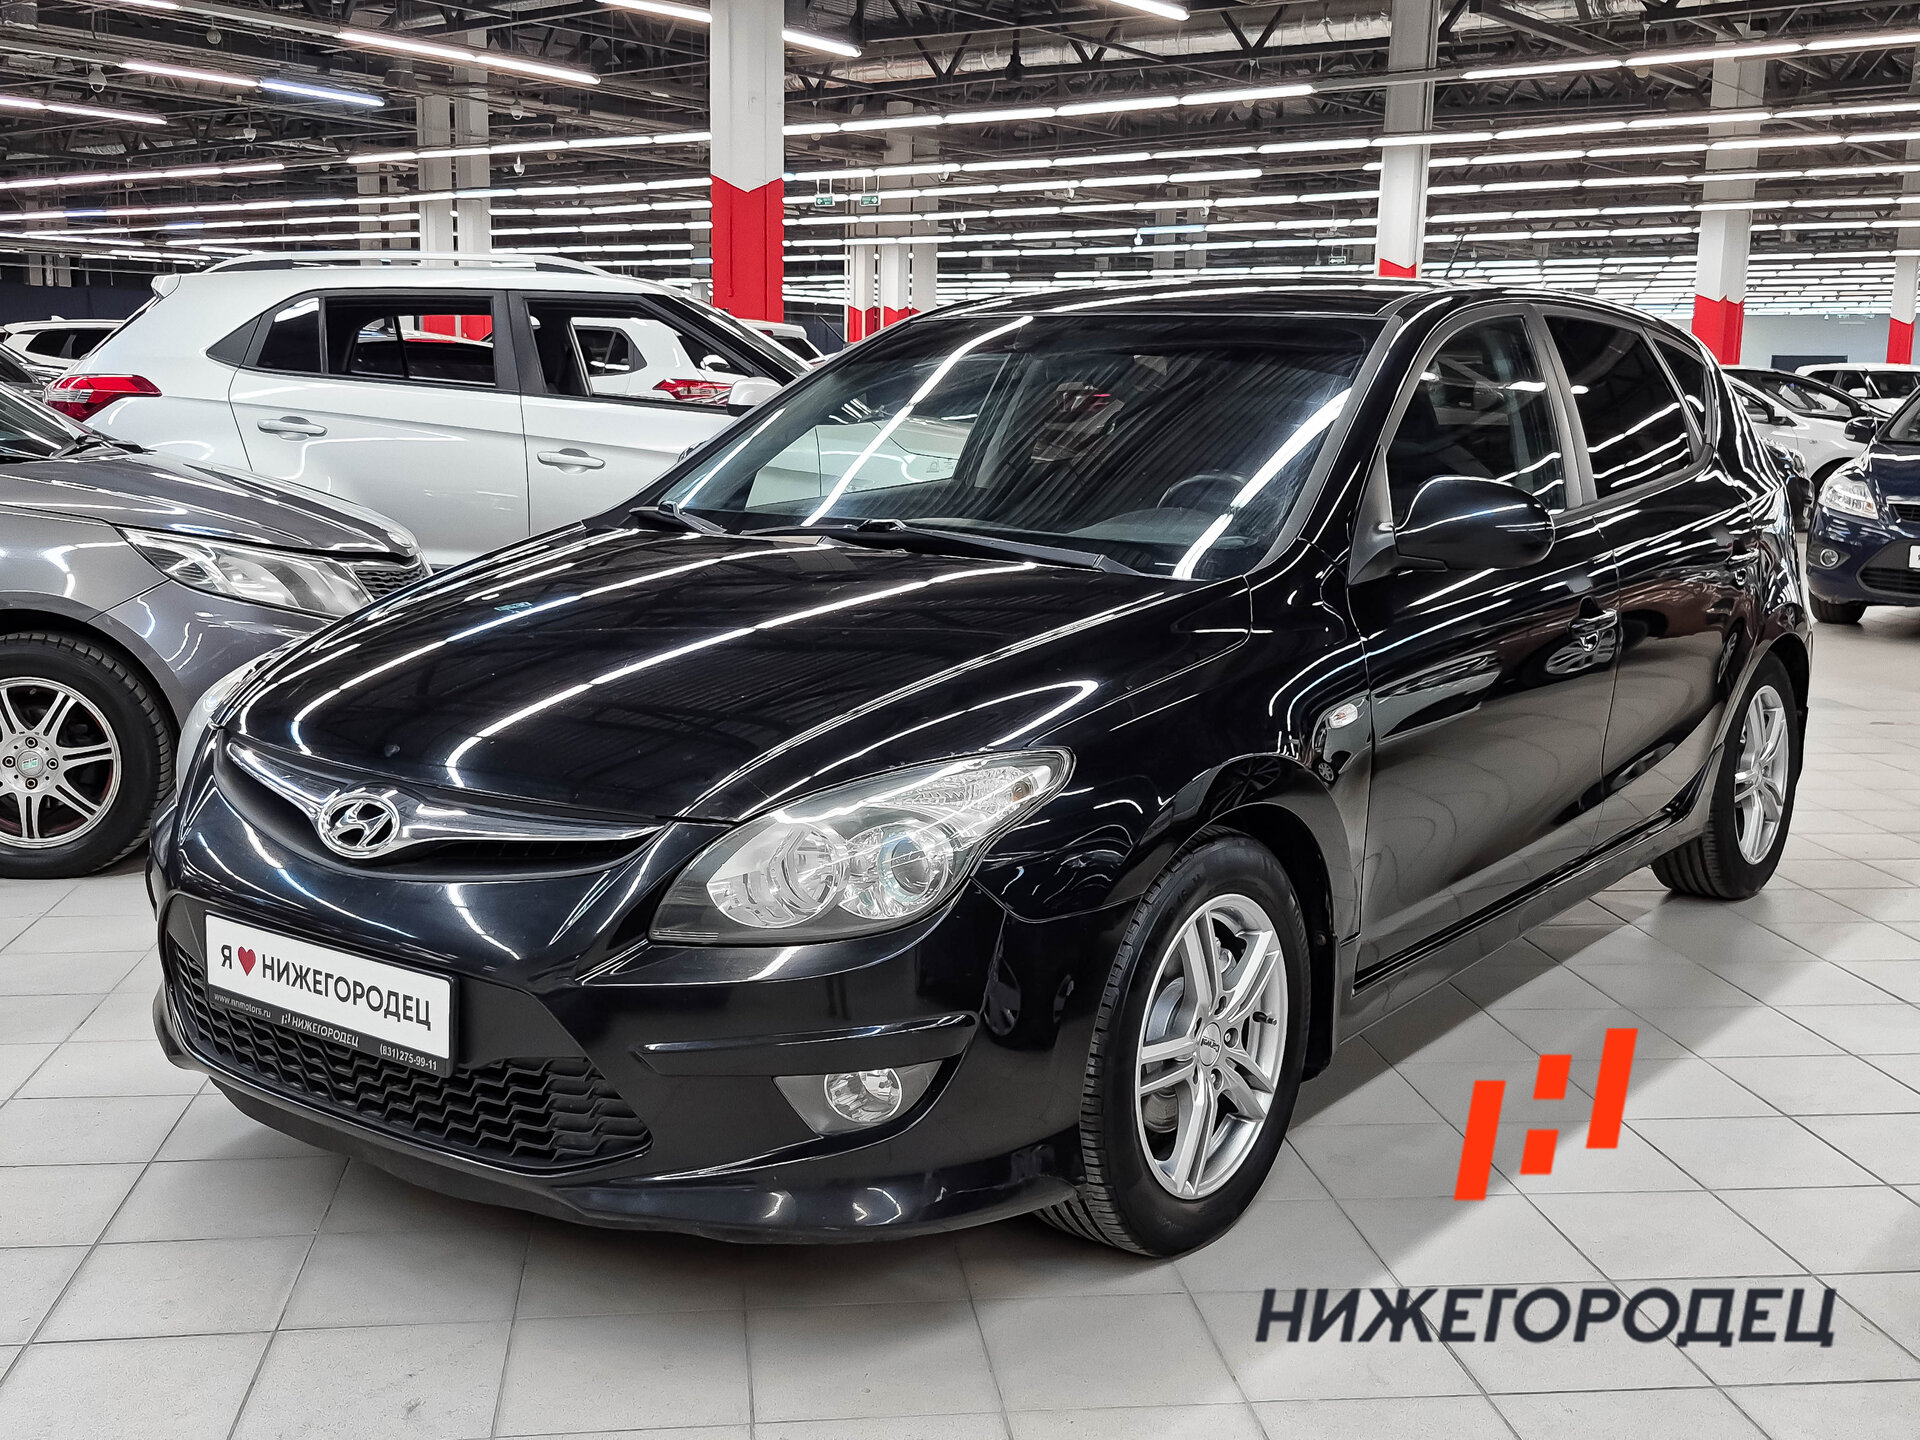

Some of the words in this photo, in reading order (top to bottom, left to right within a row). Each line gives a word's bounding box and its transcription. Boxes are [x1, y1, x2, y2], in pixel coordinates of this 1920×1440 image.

[221, 945, 232, 969] Я
[262, 953, 431, 1031] НИЖЕГОРОДЕЦ
[214, 992, 272, 1018] www.nnmotors.ru
[292, 1018, 359, 1047] НИЖЕГОРОДЕЦ
